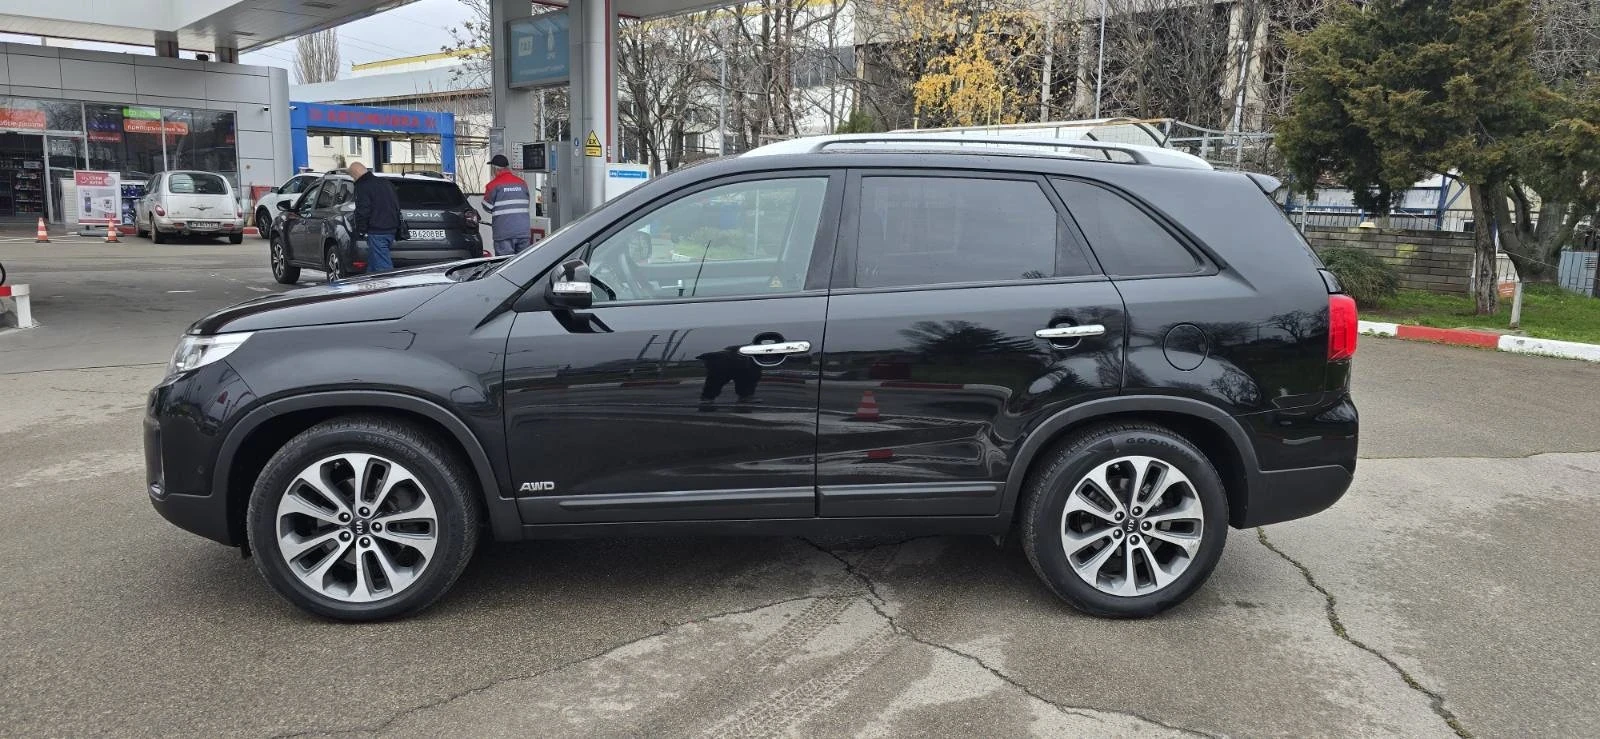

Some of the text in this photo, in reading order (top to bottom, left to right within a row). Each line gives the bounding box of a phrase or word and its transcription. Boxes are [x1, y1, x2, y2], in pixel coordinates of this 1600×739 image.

[519, 481, 555, 492] AWD
[355, 520, 364, 534] KIA
[1126, 518, 1135, 532] KIA
